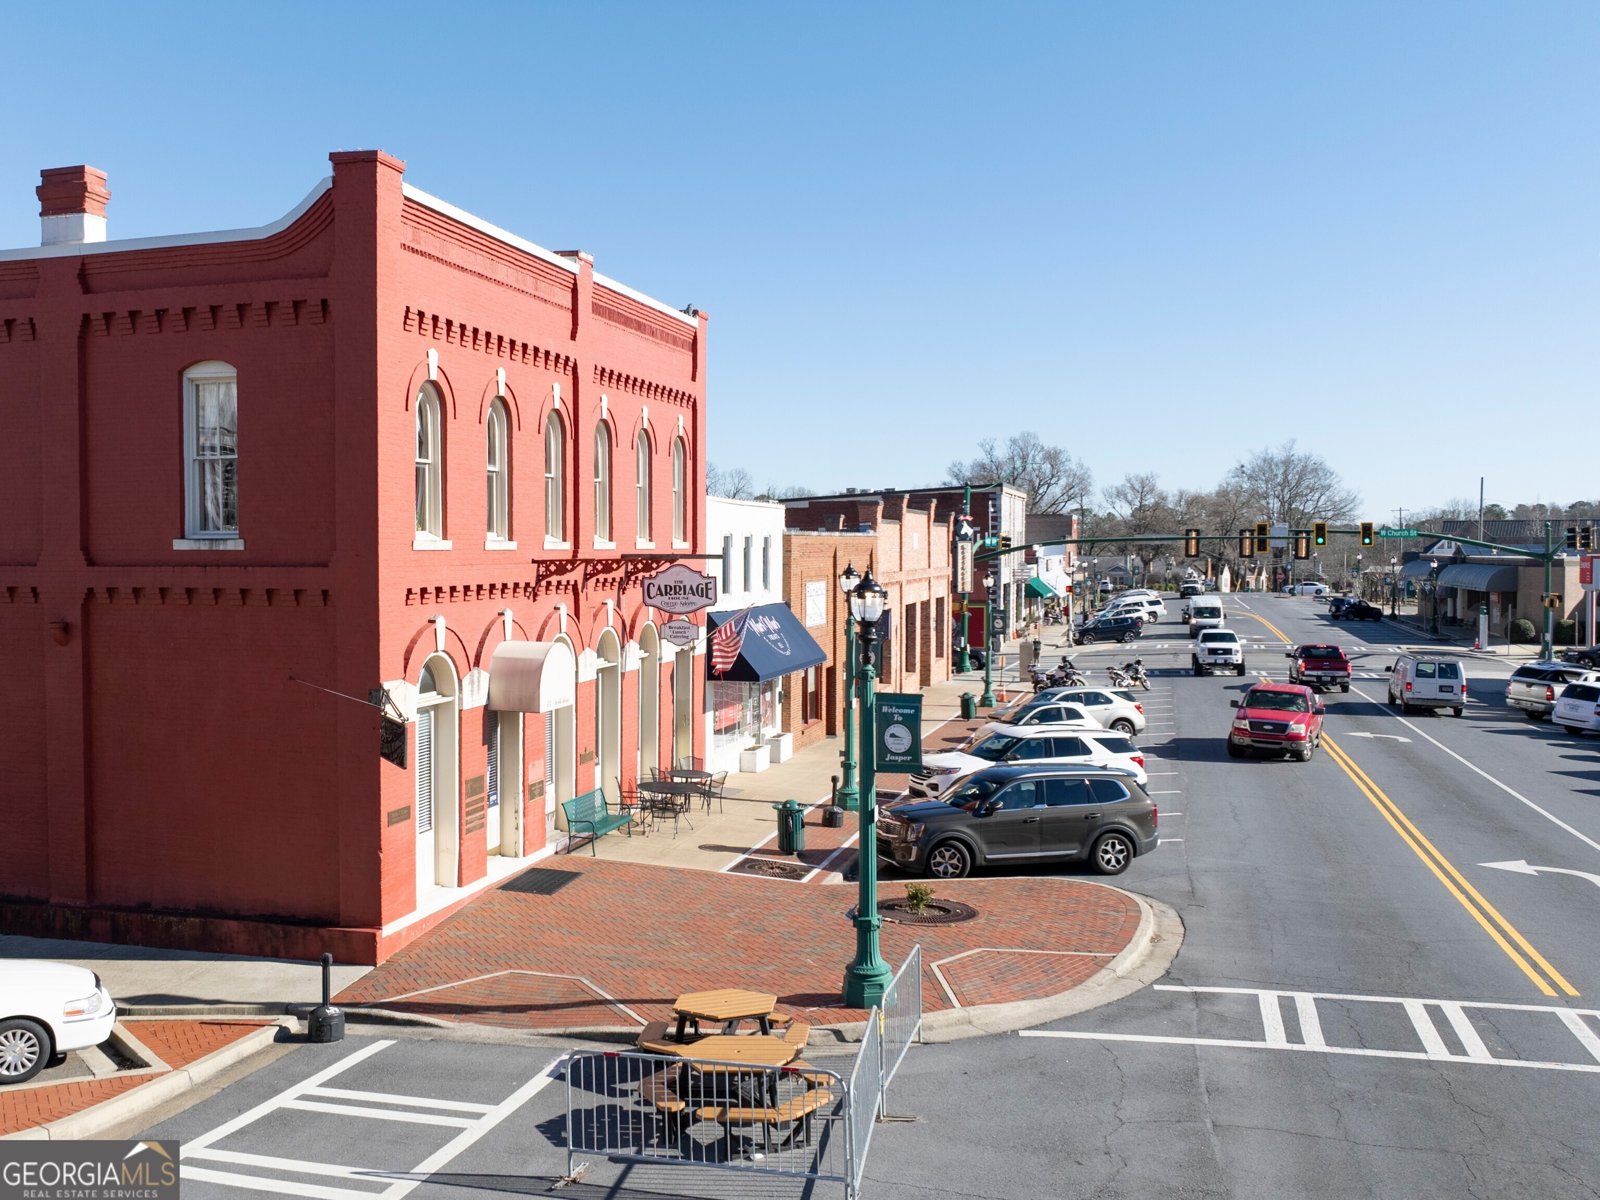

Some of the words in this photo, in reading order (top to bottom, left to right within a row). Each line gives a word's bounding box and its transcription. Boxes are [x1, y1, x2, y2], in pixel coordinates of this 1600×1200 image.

[646, 581, 712, 600] CARRIAGE
[882, 706, 915, 714] Welcome
[885, 754, 912, 762] Jasper
